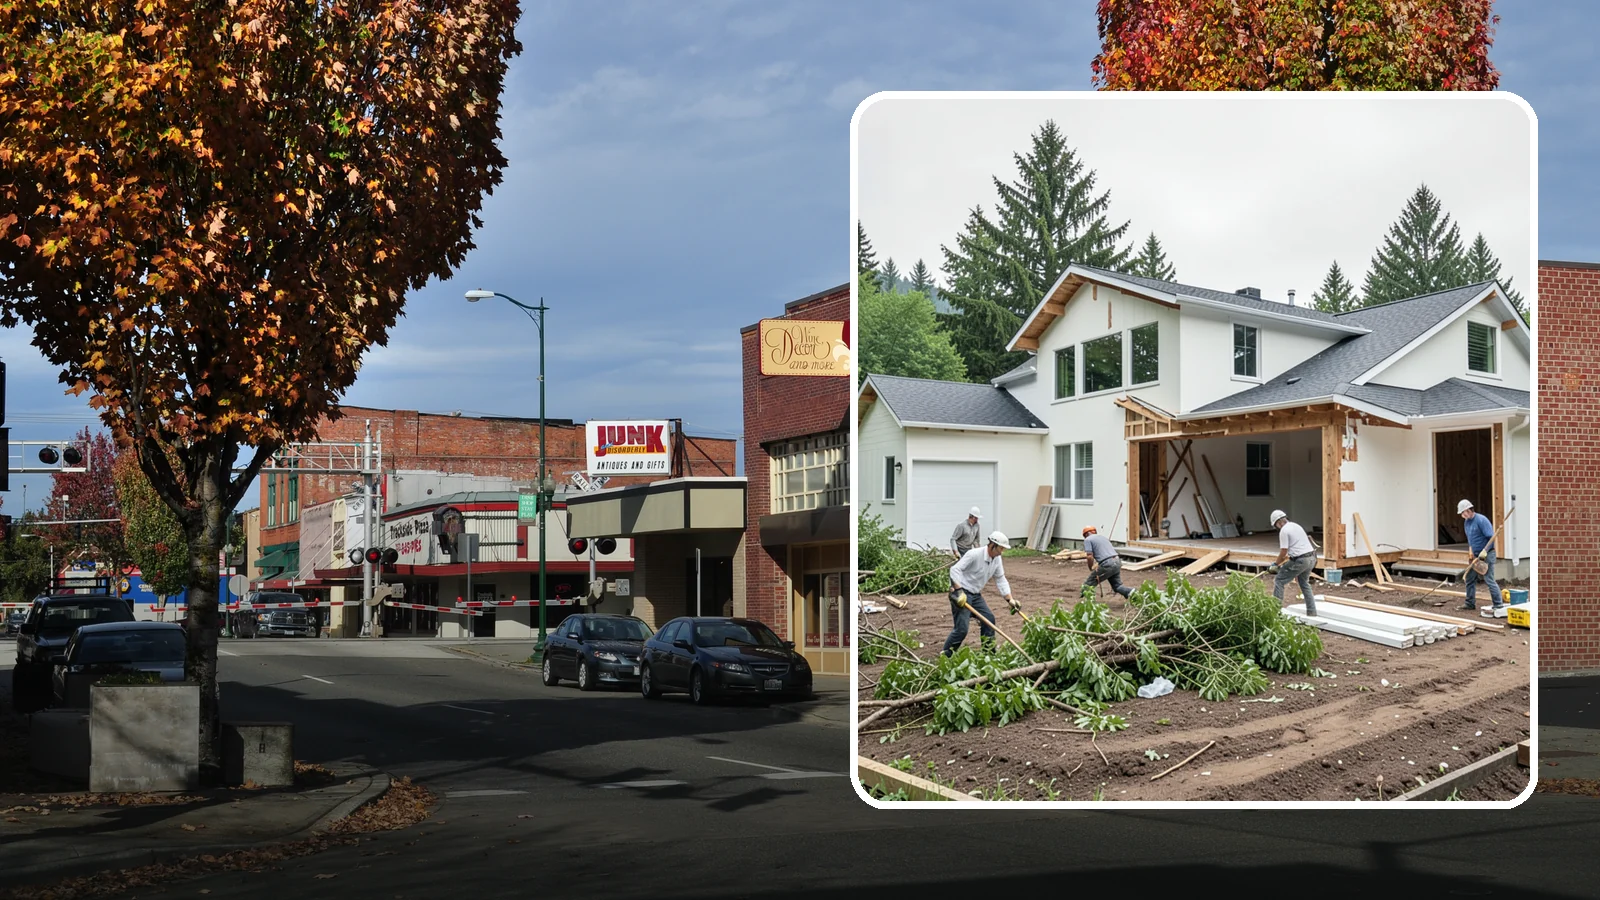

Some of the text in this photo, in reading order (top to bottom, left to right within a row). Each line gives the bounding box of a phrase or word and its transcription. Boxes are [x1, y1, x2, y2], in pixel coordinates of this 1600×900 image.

[595, 425, 665, 457] JUNK
[607, 446, 646, 454] DISORDERLY
[597, 460, 666, 470] ANTIQUES AND GIFTS
[414, 520, 429, 535] Pizza
